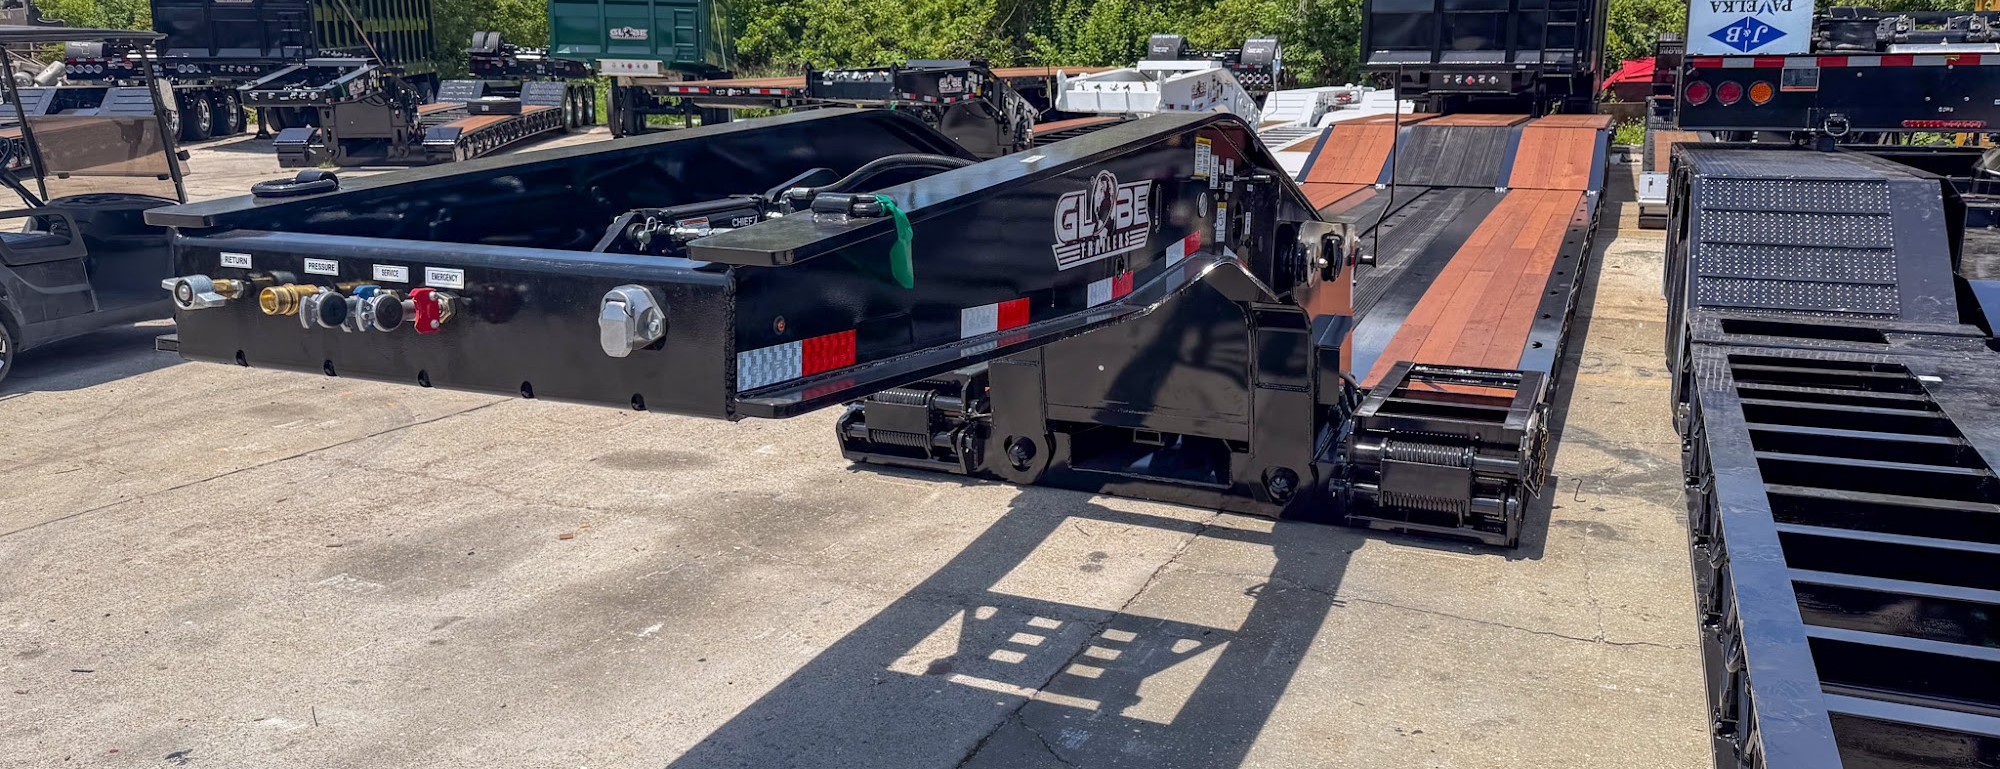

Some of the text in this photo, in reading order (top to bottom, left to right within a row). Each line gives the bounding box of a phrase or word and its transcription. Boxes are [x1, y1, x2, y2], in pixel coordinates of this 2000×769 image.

[1709, 0, 1792, 16] PAVELKA
[1056, 171, 1150, 243] GLOBE
[731, 216, 753, 228] CHIEF
[1080, 231, 1131, 258] TRAILERS
[224, 256, 248, 265] RETURN
[308, 262, 335, 272] PRESSURE
[381, 268, 400, 278] SERVICE
[431, 272, 458, 283] EMERGENCY
